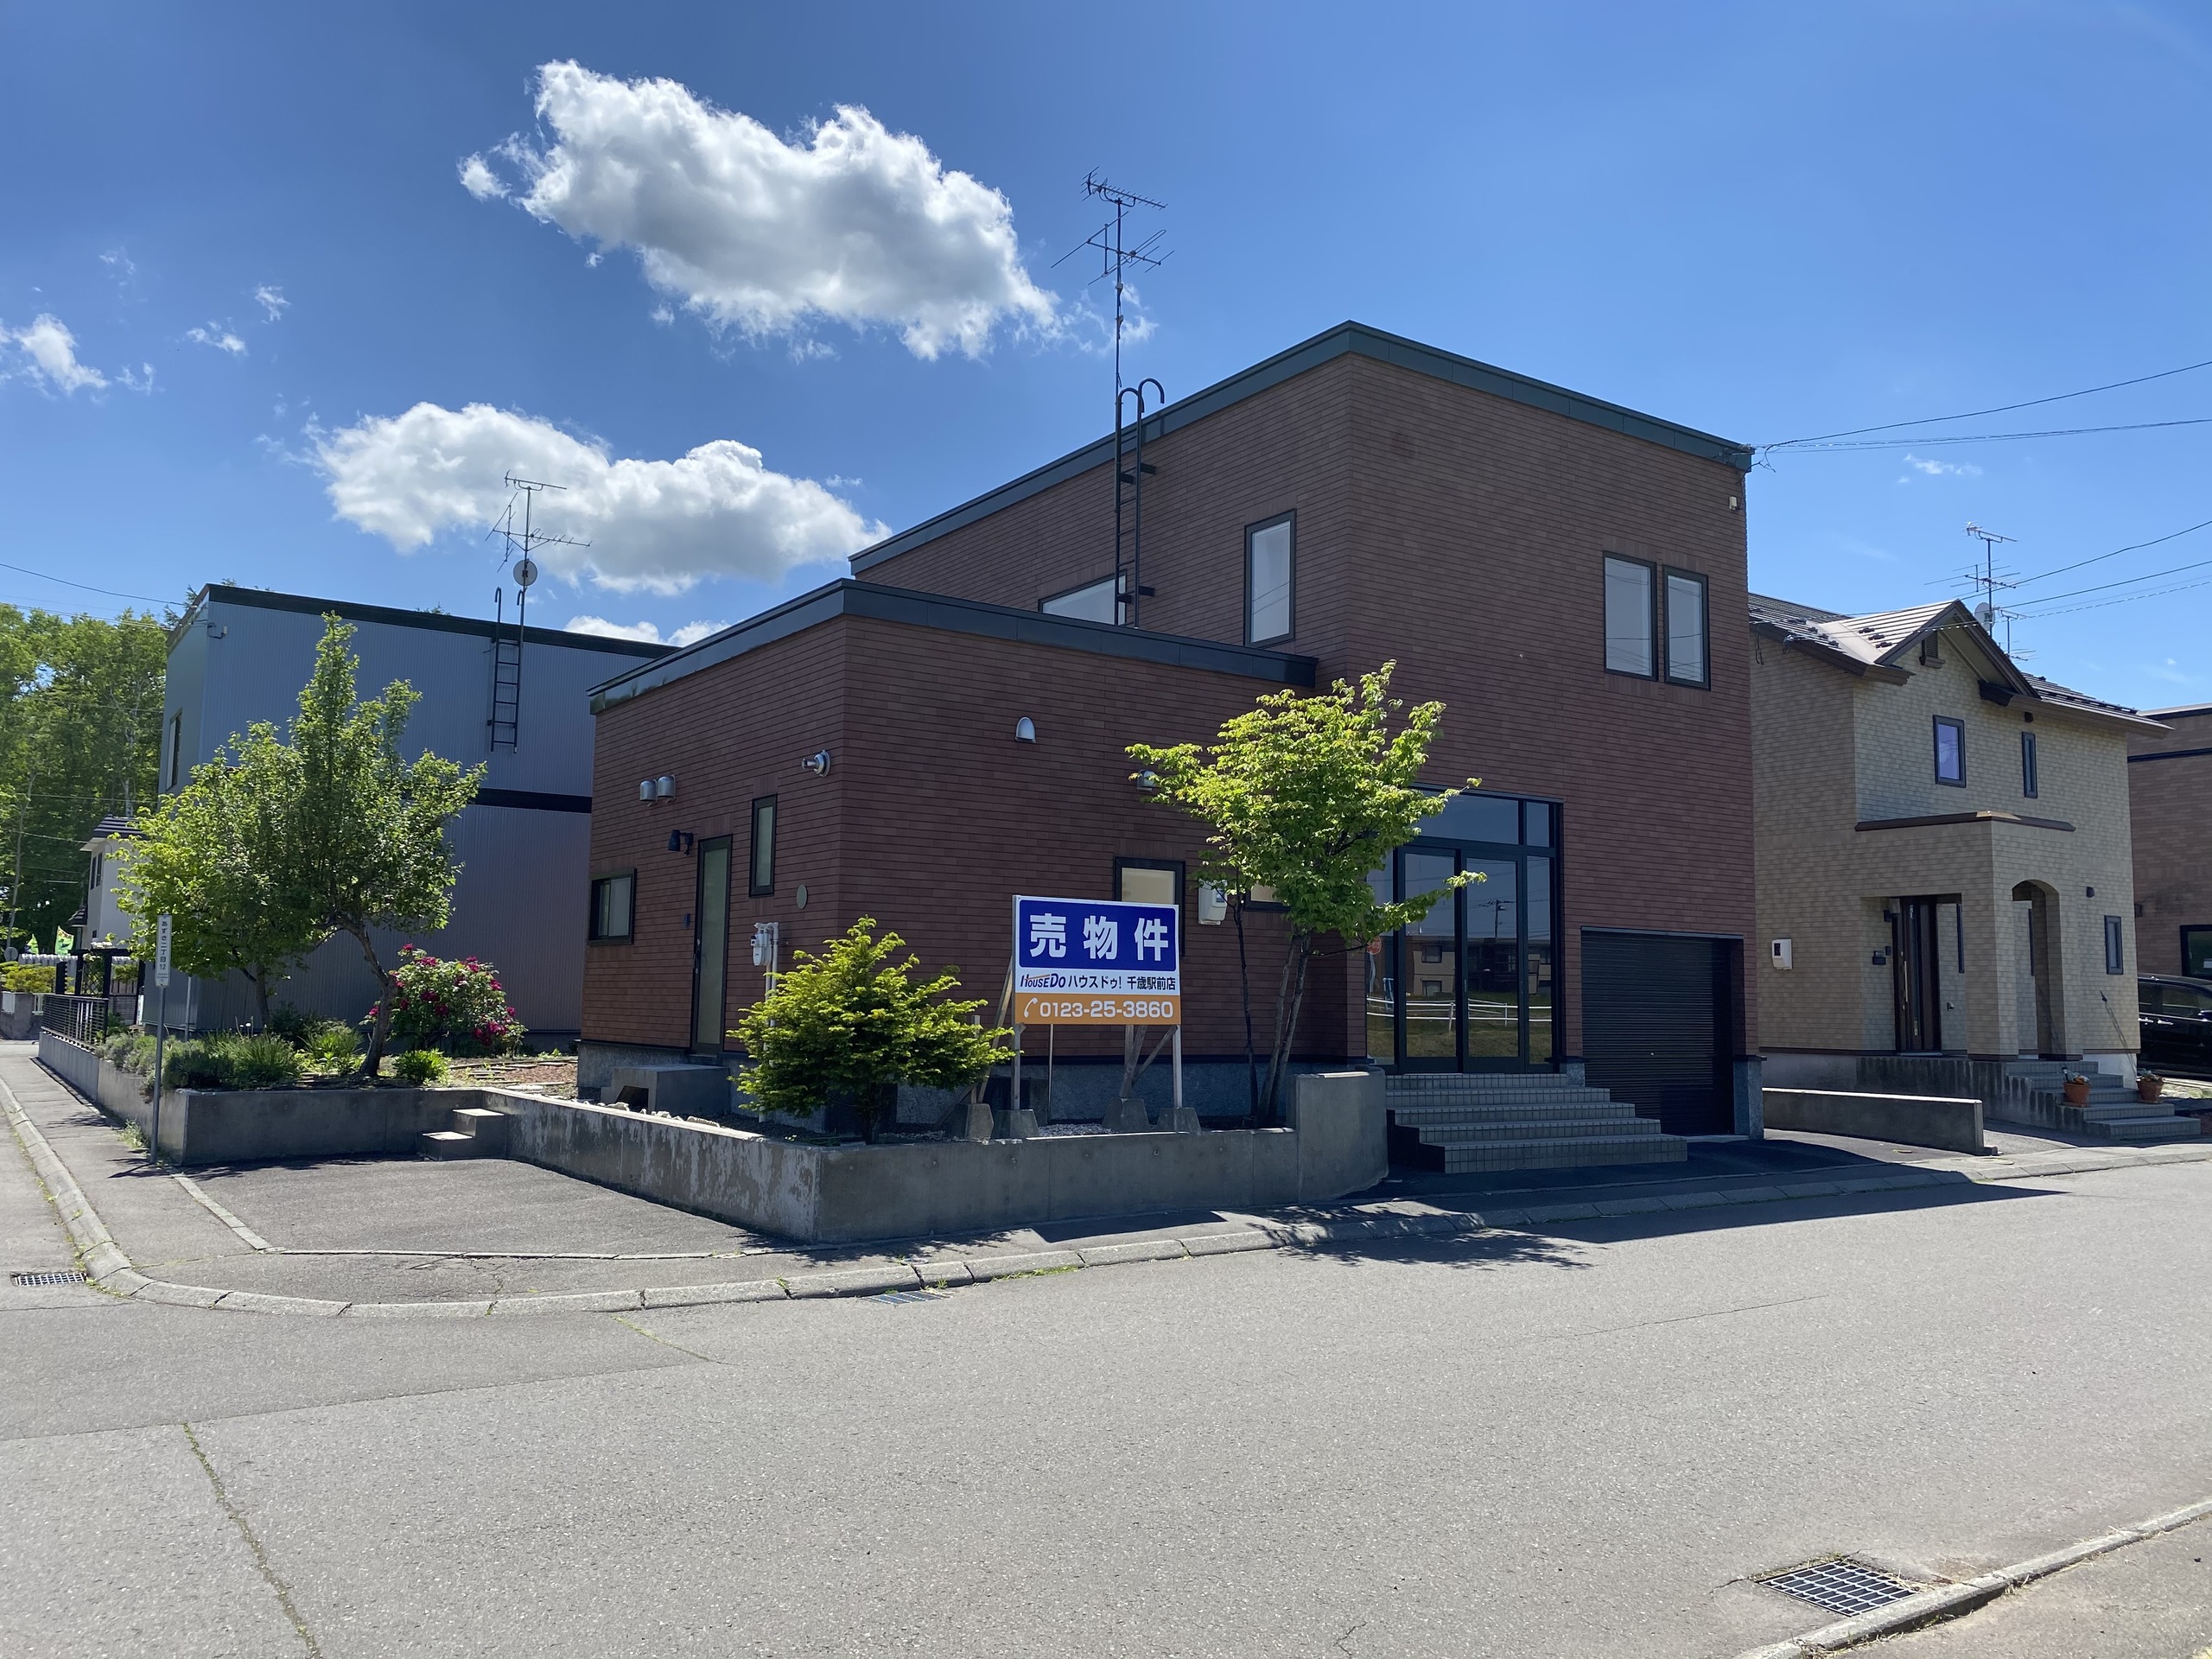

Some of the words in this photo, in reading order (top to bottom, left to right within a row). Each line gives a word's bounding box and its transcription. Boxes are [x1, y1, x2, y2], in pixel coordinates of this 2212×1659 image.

[1030, 913, 1168, 962] 売物件
[1127, 976, 1176, 991] 千歳駅前店
[1039, 1001, 1173, 1019] 0123-25-3860
